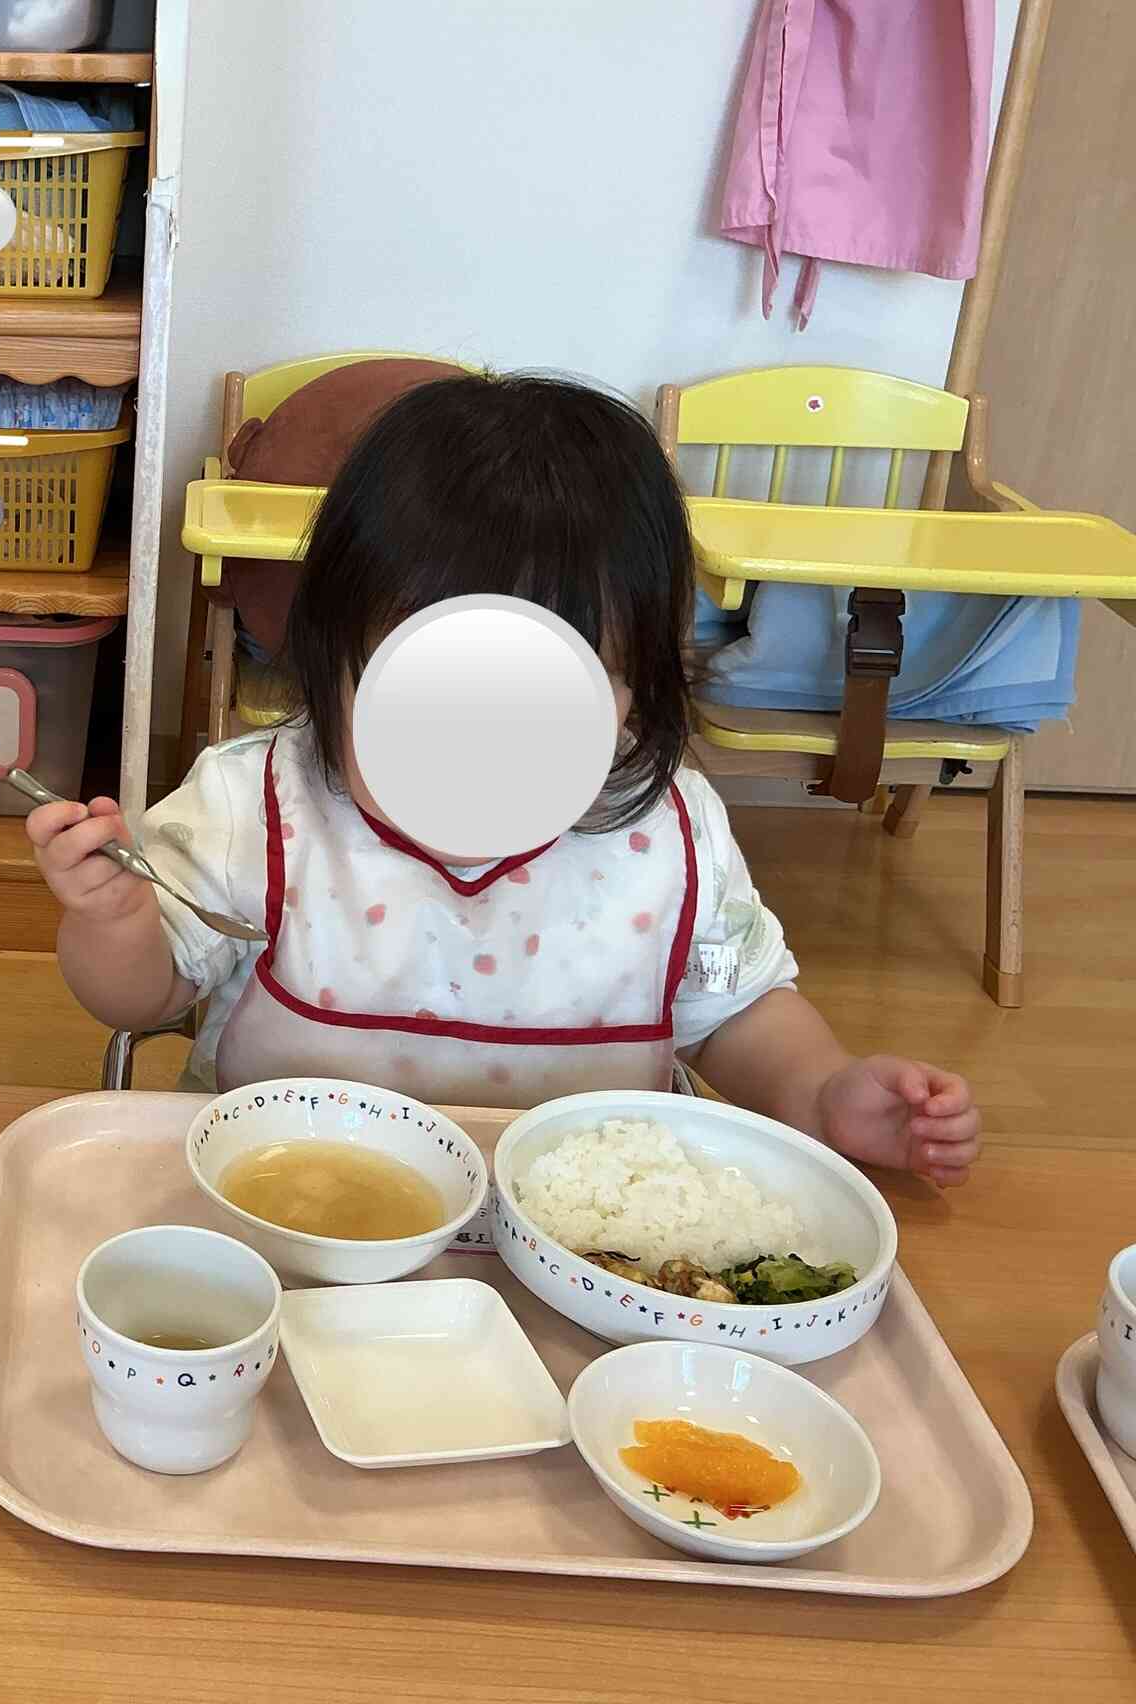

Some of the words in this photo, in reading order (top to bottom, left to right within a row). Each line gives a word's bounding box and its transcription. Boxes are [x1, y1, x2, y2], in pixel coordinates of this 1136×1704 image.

[214, 1108, 221, 1121] B
[232, 1106, 241, 1119] C
[254, 1096, 265, 1108] D
[283, 1089, 295, 1103] E
[310, 1096, 319, 1110] F
[338, 1092, 348, 1104] G
[368, 1104, 382, 1119] H
[402, 1107, 410, 1119] I
[425, 1121, 437, 1133] J
[446, 1139, 454, 1154] K
[511, 1226, 518, 1240] A
[528, 1238, 537, 1251] B
[549, 1264, 560, 1275] C
[581, 1277, 594, 1291] D
[619, 1294, 635, 1309] E
[654, 1311, 665, 1325] F
[689, 1313, 703, 1327] G
[730, 1324, 746, 1338] H
[772, 1317, 783, 1330] I
[806, 1314, 819, 1328] J
[838, 1308, 846, 1322] K
[91, 1340, 101, 1354] O
[127, 1367, 136, 1379] P
[177, 1373, 197, 1387] Q
[234, 1363, 245, 1377] R
